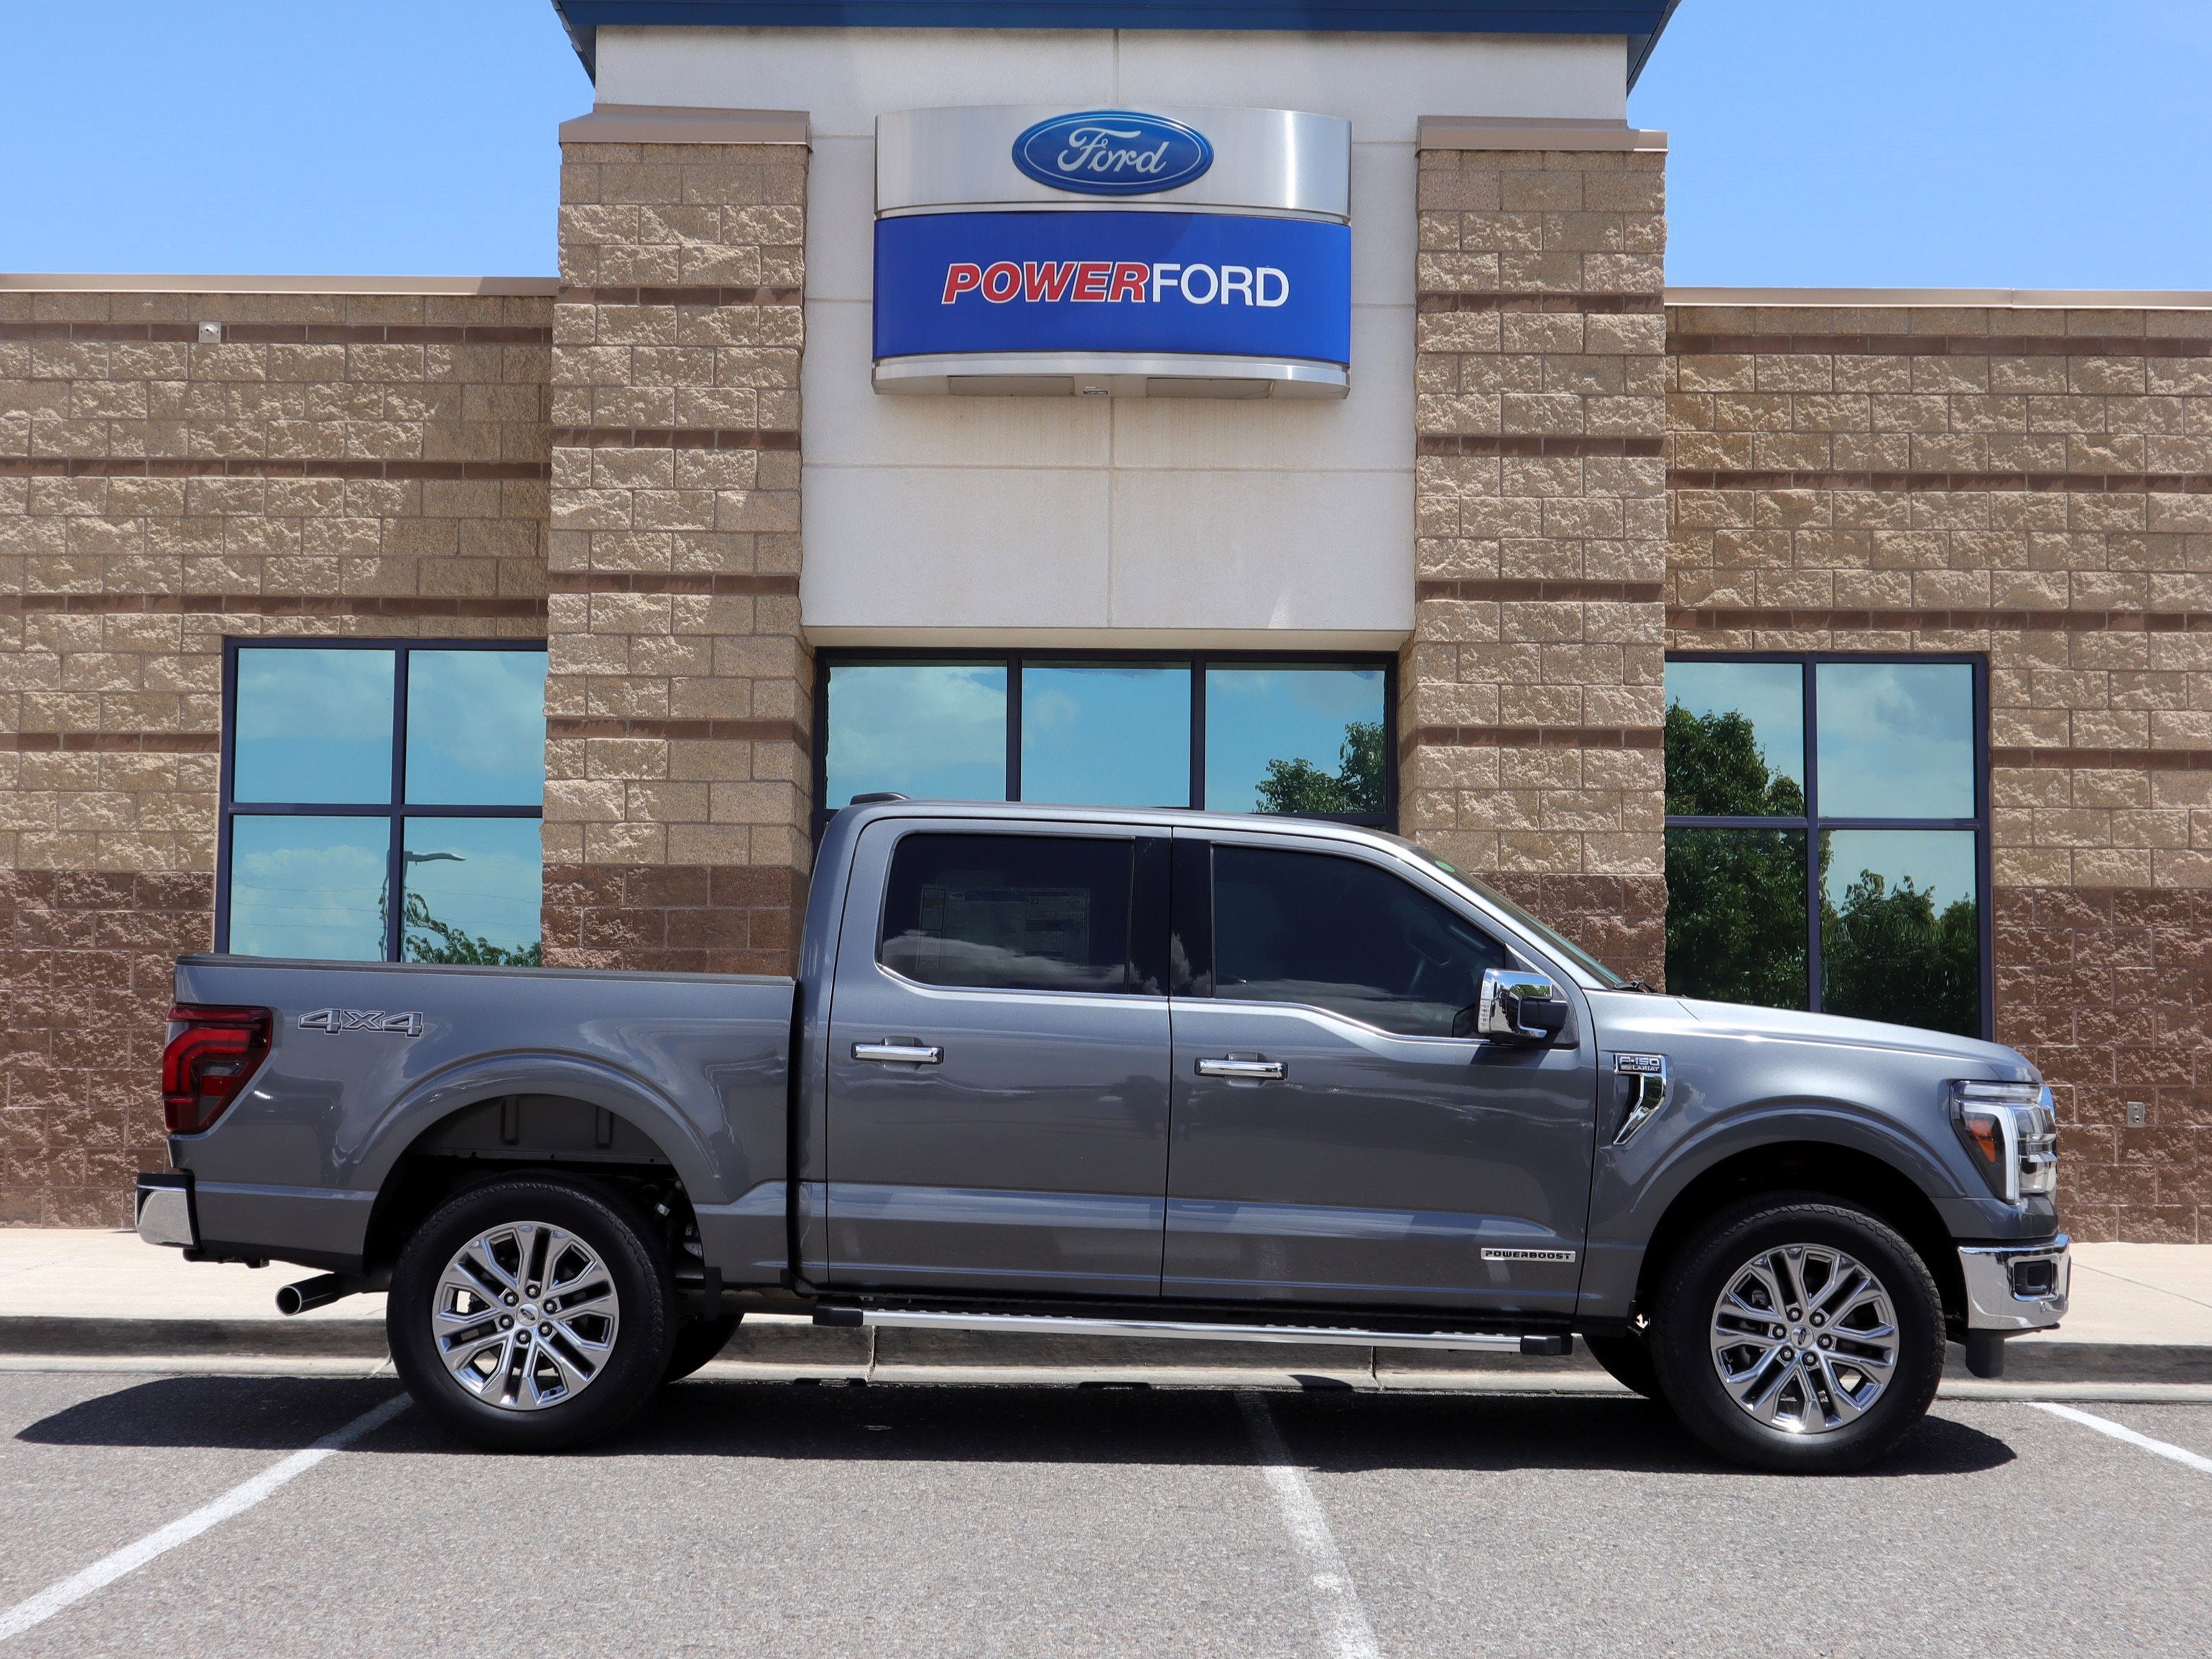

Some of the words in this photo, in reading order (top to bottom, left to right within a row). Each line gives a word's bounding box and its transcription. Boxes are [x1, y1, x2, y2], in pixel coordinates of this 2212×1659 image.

[1057, 126, 1170, 173] Ford
[1619, 1056, 1660, 1066] F-150
[1485, 1250, 1571, 1260] POWERBOOST
